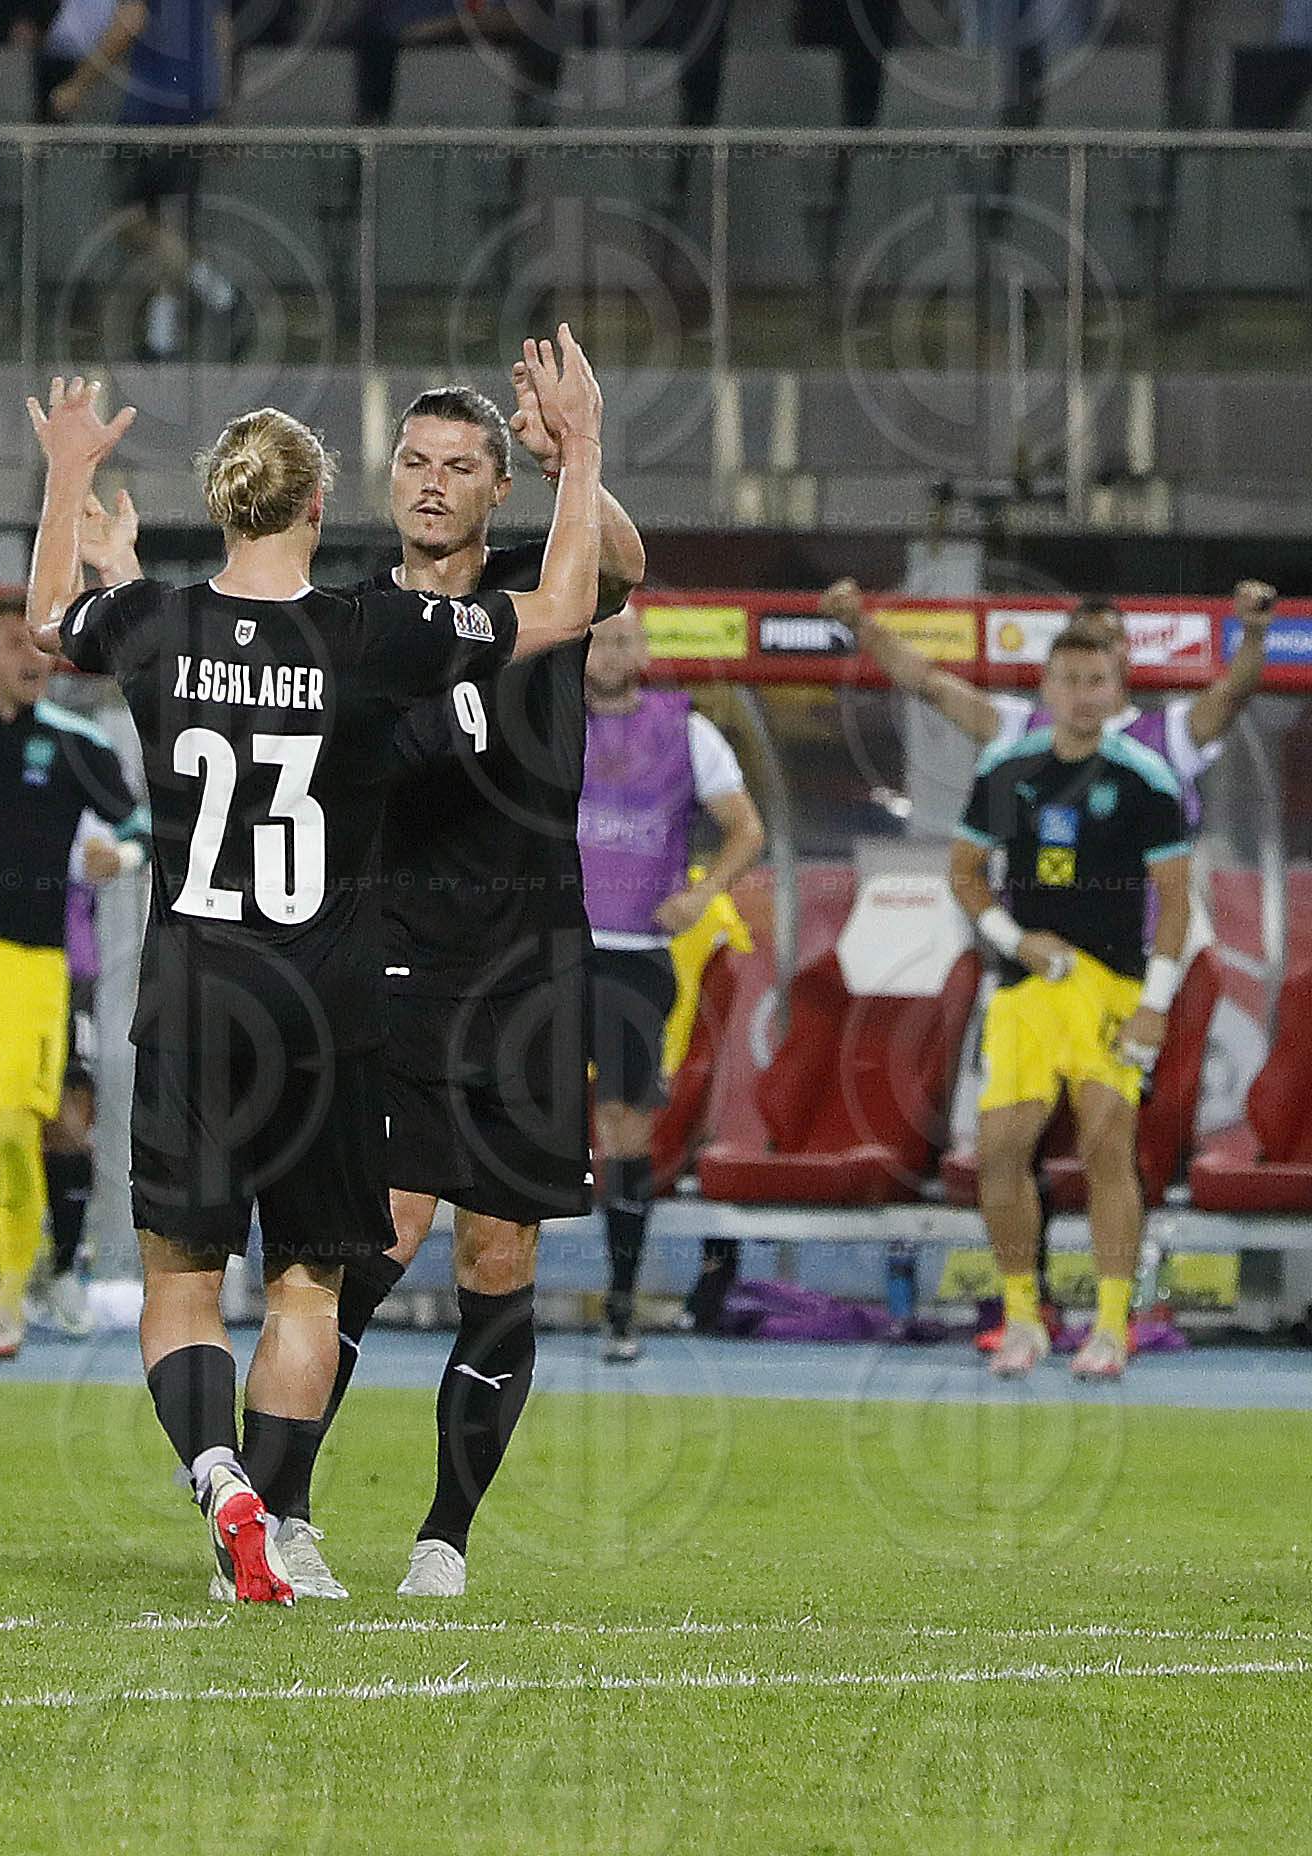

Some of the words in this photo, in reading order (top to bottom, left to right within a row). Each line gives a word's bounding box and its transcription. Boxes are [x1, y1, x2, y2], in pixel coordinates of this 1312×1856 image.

[173, 655, 324, 710] X.SCHLAGER
[451, 681, 488, 754] 9
[171, 727, 326, 925] 23
